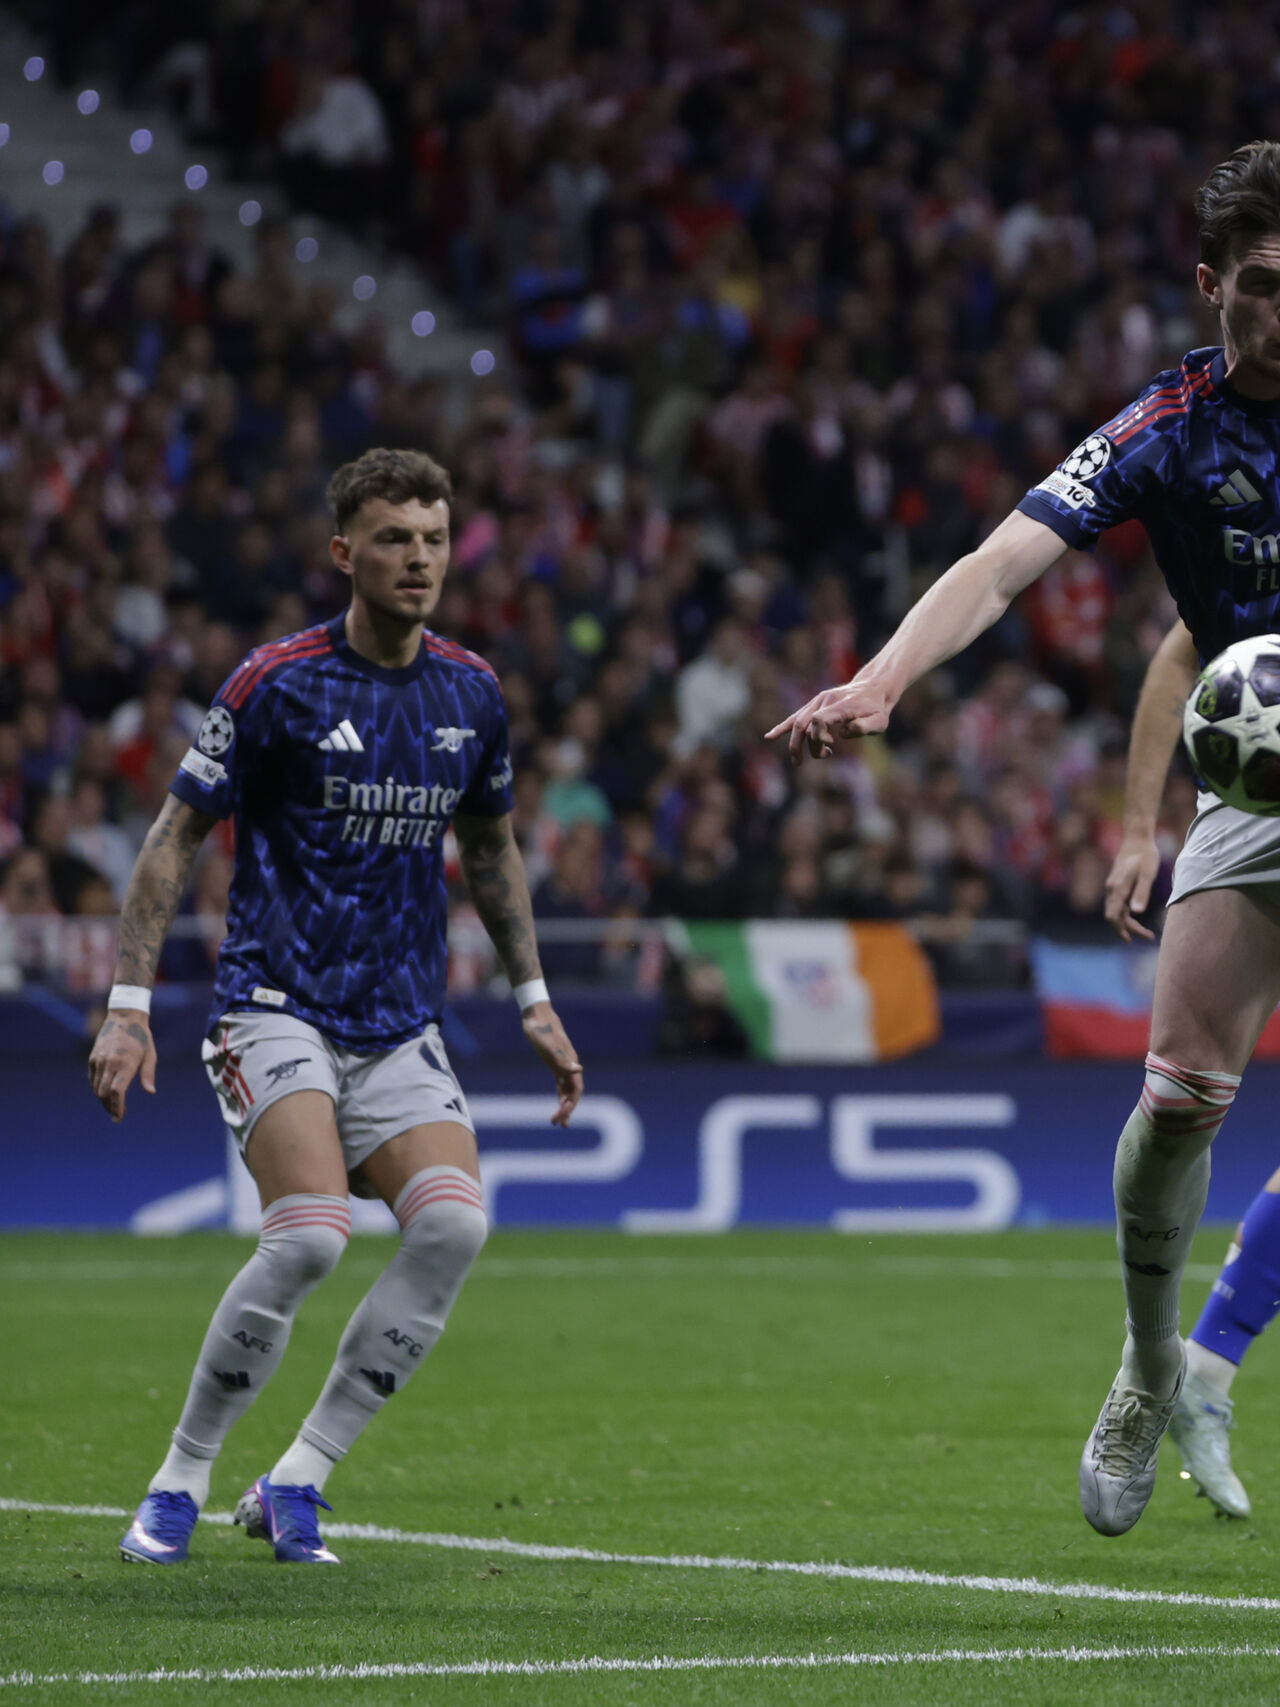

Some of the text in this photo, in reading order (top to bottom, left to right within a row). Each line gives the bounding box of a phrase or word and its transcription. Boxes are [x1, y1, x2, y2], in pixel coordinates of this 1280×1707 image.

[340, 814, 443, 847] FLY BETTE
[470, 1094, 1022, 1234] PS5
[232, 1329, 273, 1354] AFC
[382, 1327, 424, 1358] AFC
